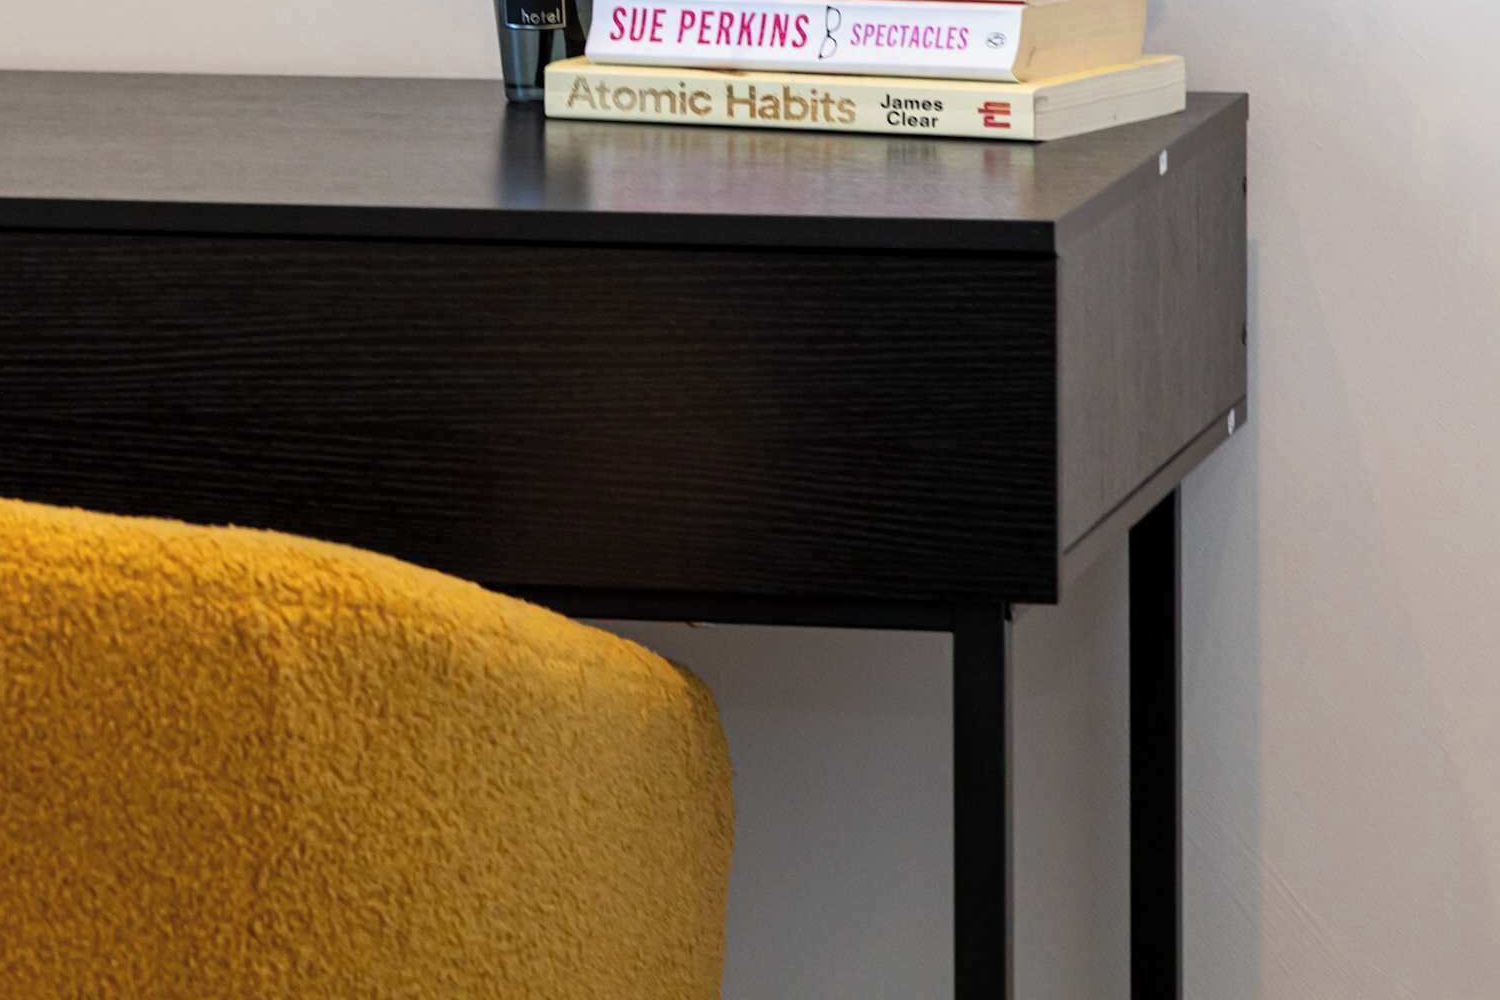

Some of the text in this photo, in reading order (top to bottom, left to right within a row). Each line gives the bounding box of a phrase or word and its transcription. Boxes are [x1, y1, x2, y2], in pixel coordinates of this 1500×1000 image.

[521, 7, 561, 25] hotel
[610, 6, 971, 51] SUE PERKINS SPECTACLES
[567, 74, 856, 125] Atomic Habits
[881, 93, 944, 112] James
[886, 110, 939, 129] Clear
